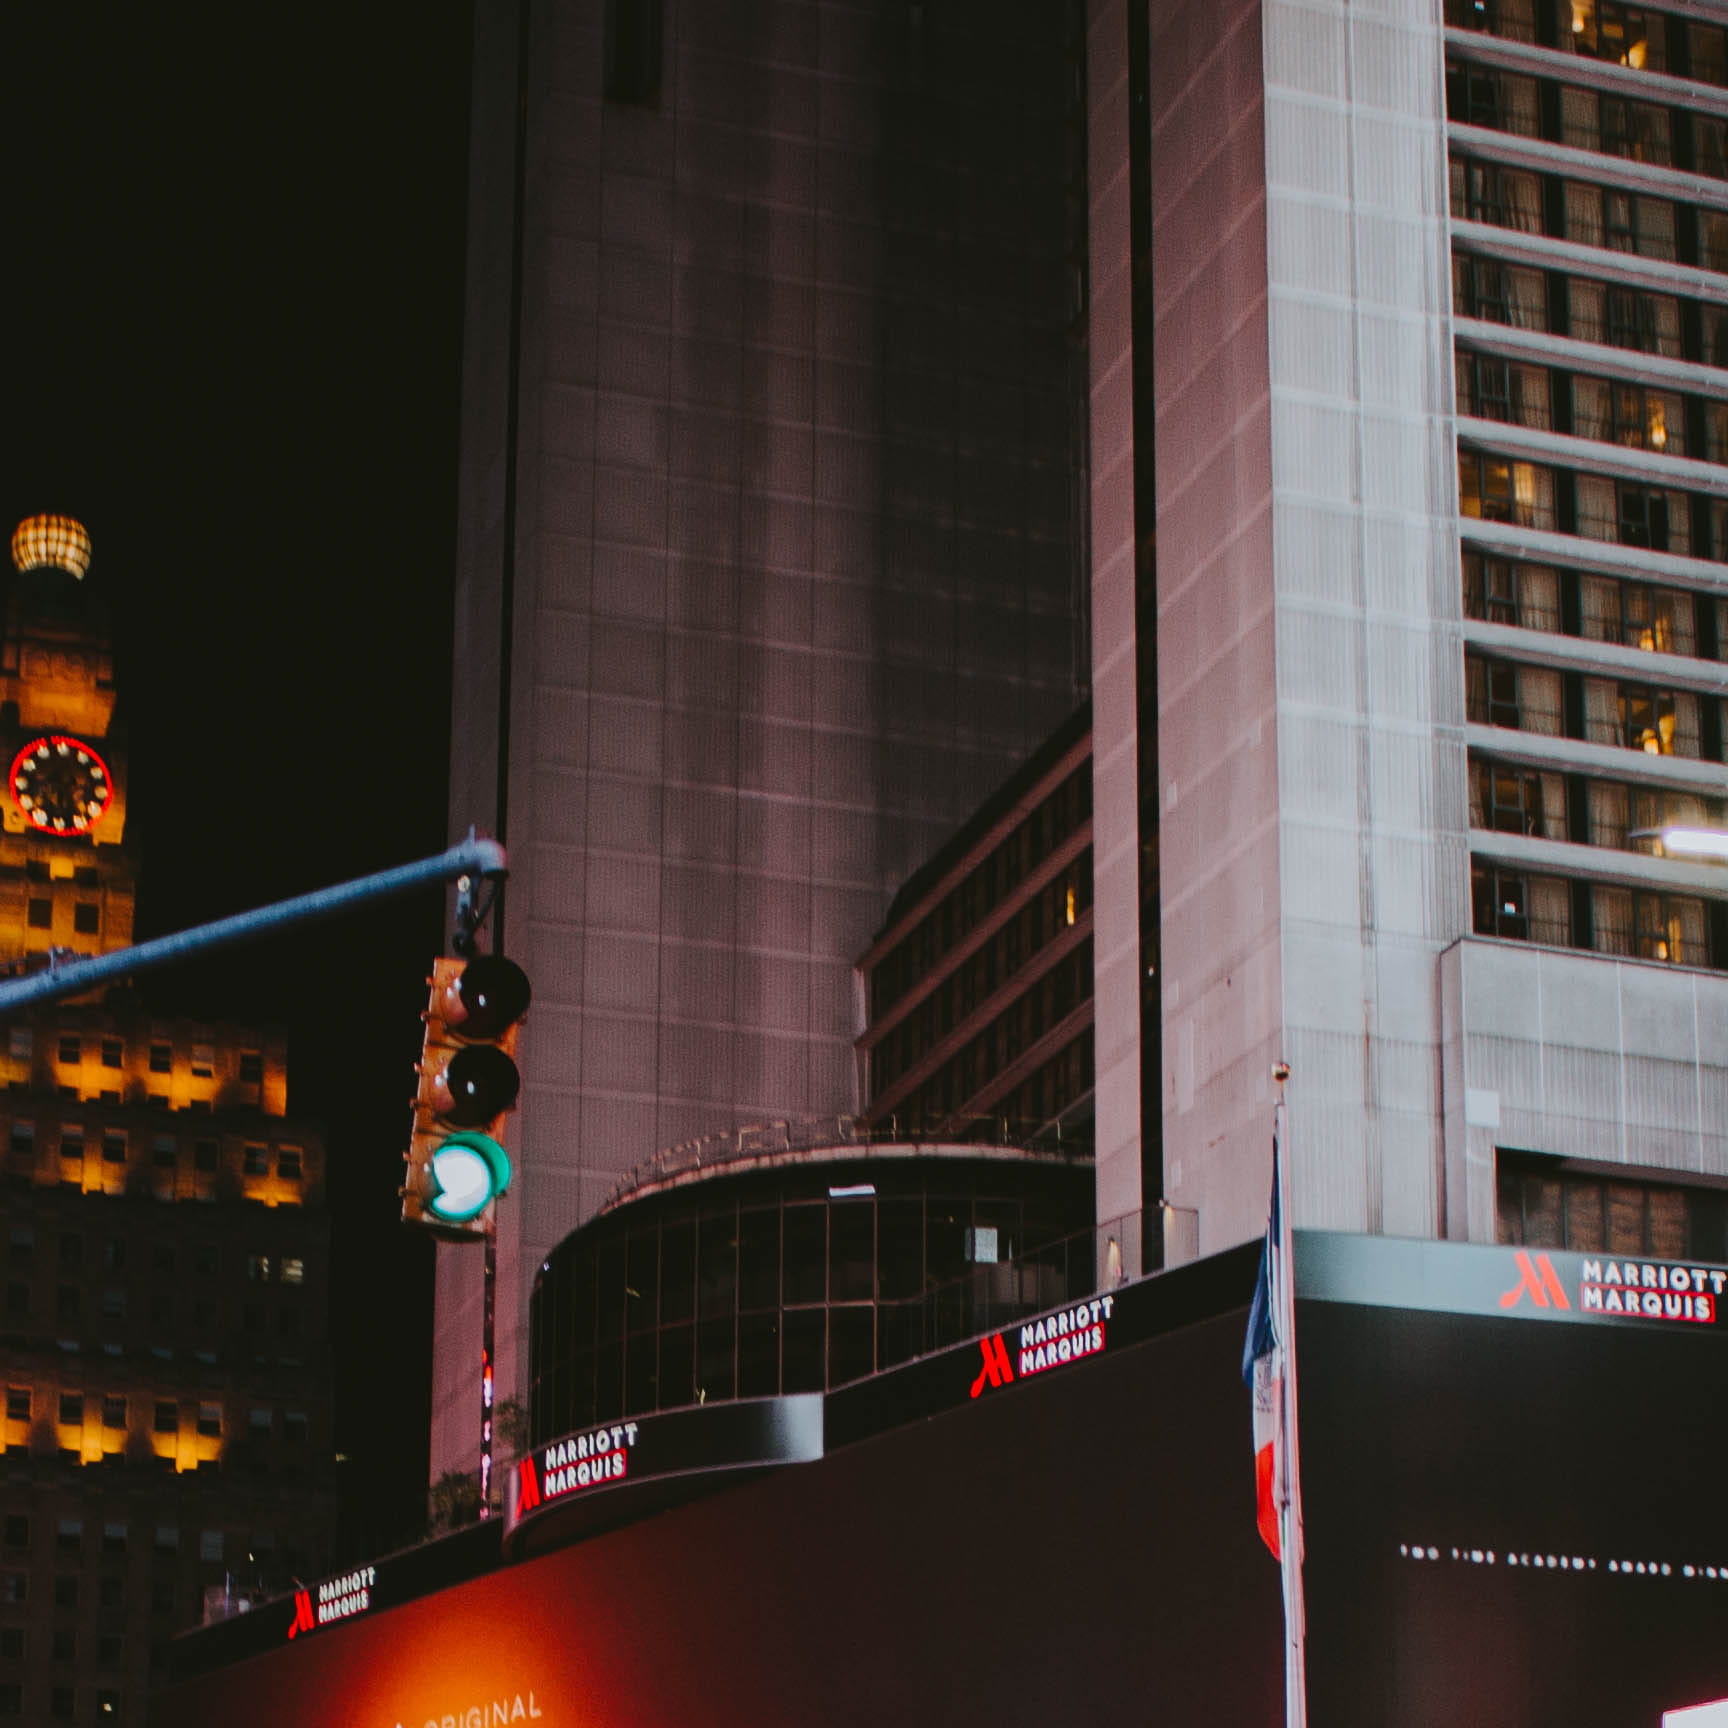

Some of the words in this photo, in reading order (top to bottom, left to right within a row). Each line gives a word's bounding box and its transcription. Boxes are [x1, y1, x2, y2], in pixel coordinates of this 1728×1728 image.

[1582, 1259, 1727, 1294] MARRIOTT
[1021, 1295, 1114, 1346] MARRIOTT
[1582, 1287, 1712, 1321] MARQUIS
[1020, 1323, 1105, 1376] MARQUIS
[545, 1423, 638, 1470] MARRIOTT
[545, 1450, 625, 1498] MARQUIS
[319, 1567, 376, 1602] MARRIOTT
[319, 1588, 370, 1624] MARQUIS
